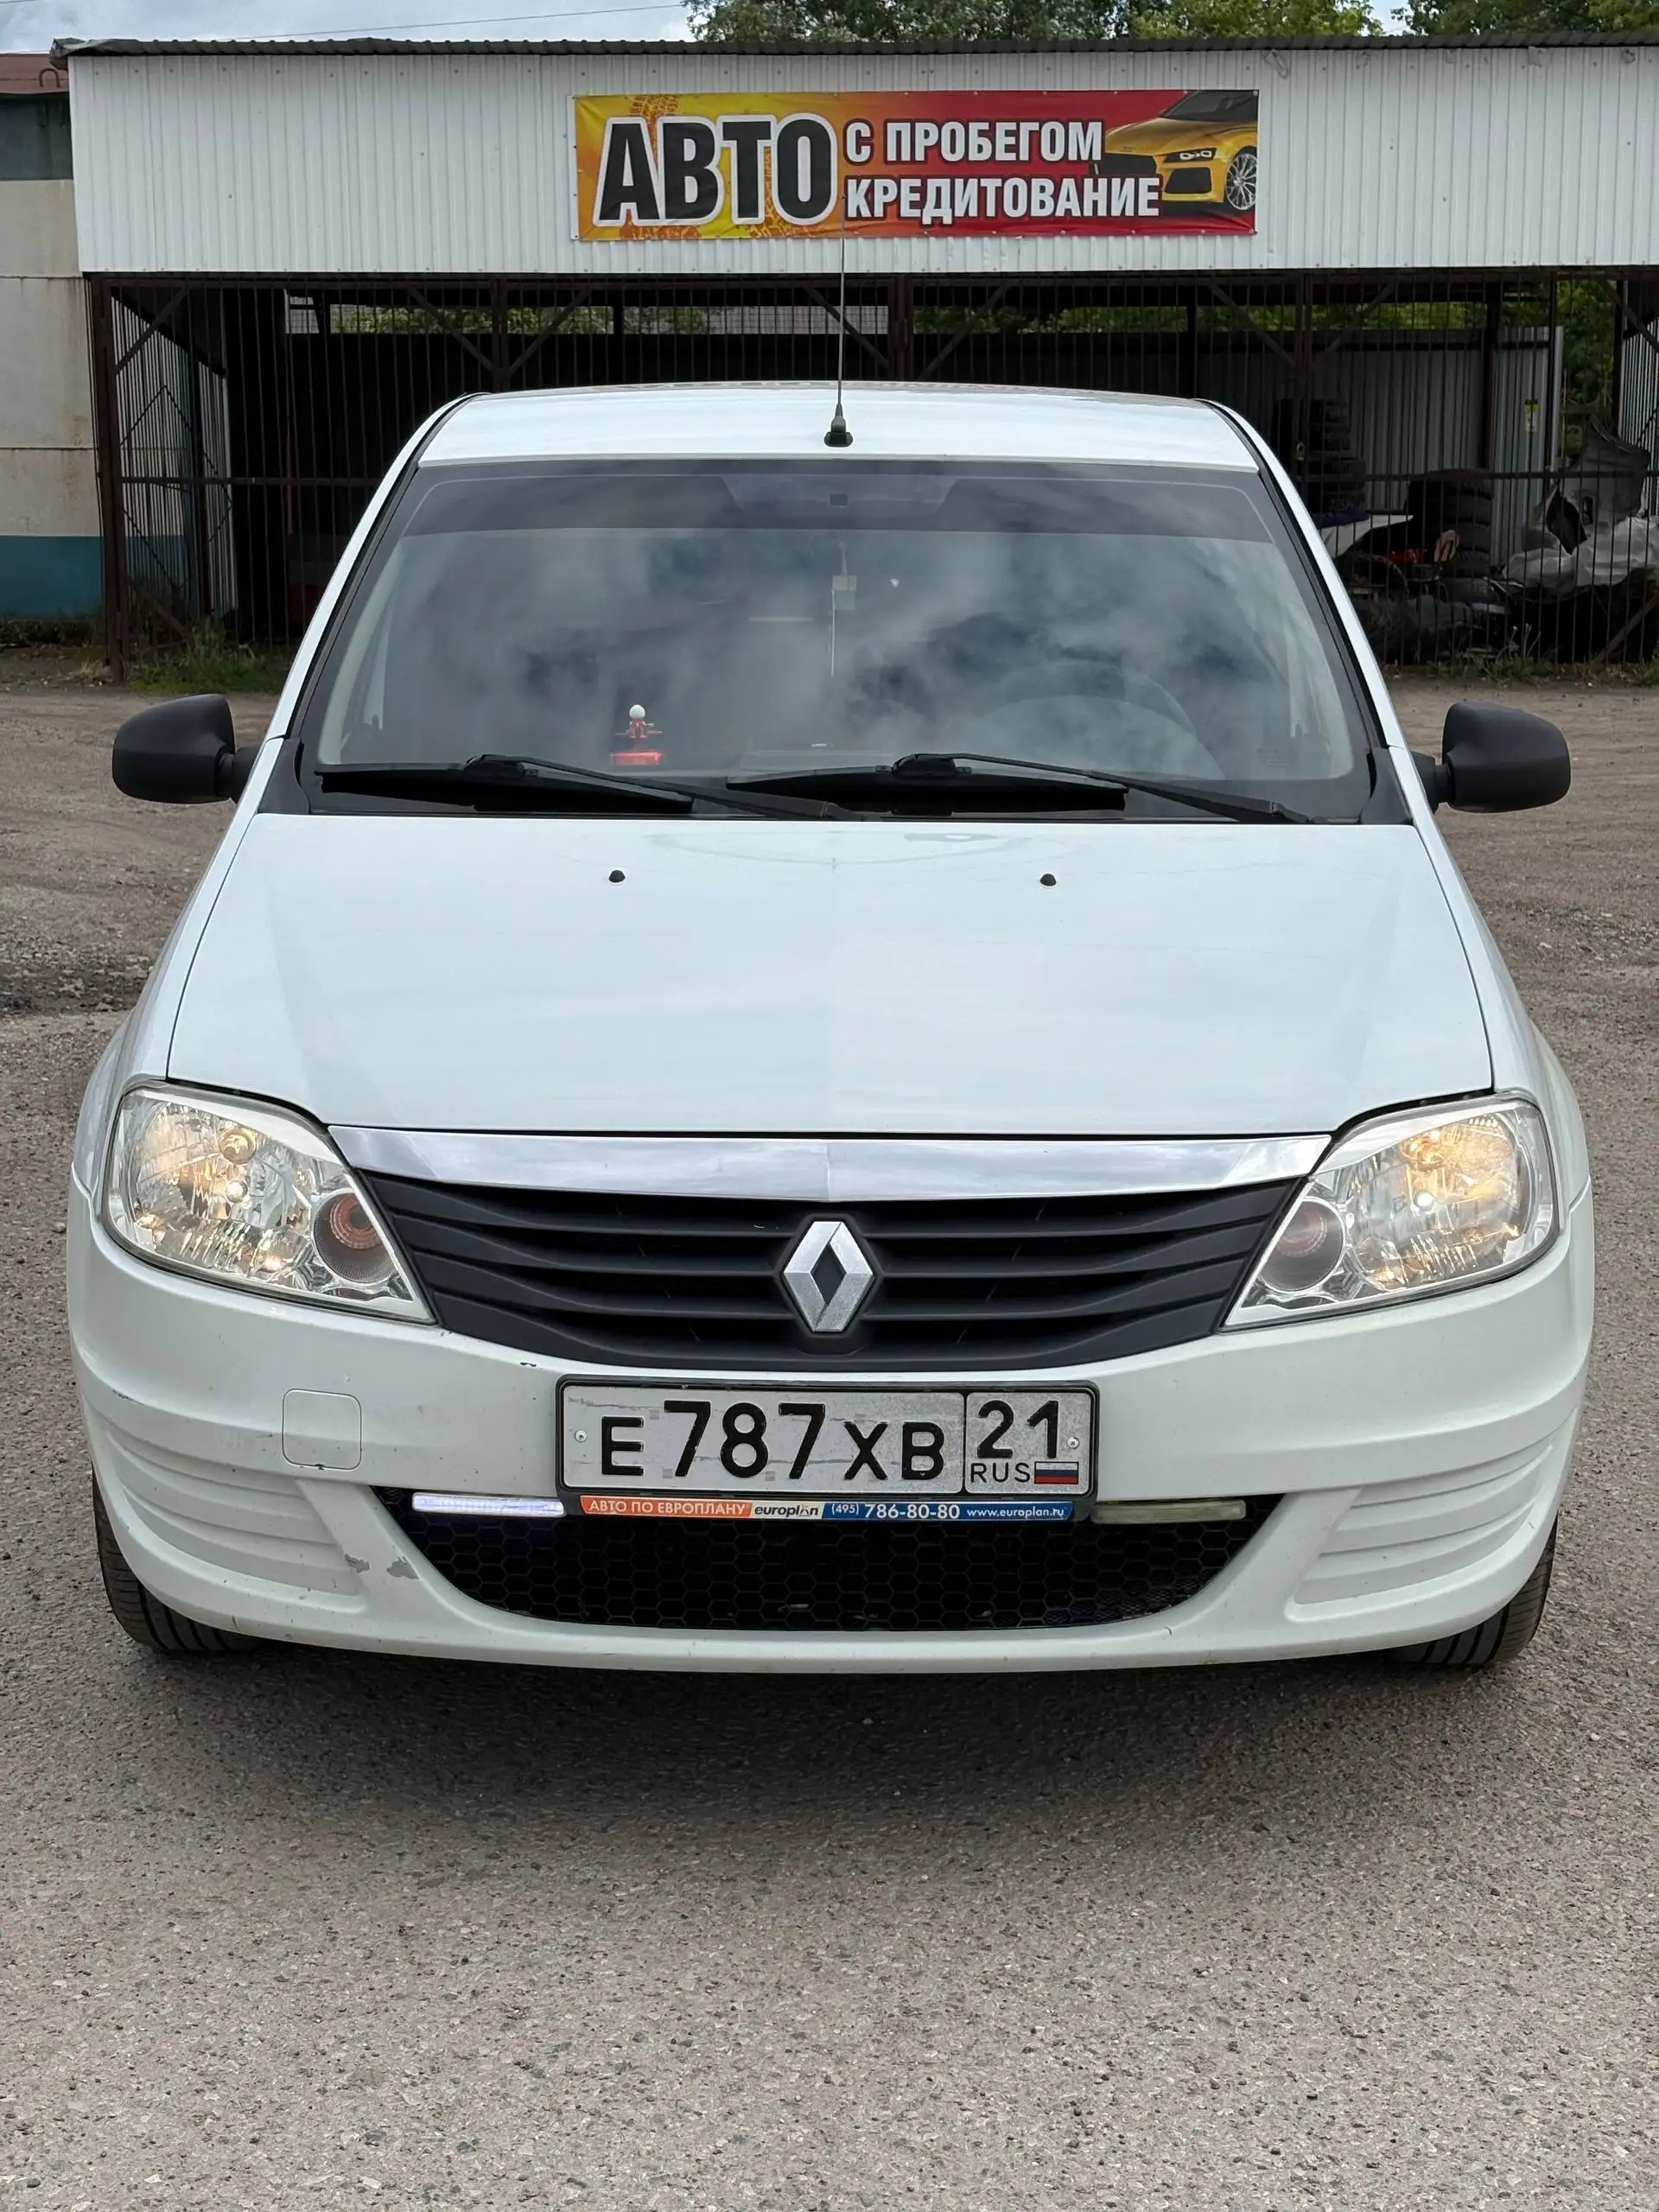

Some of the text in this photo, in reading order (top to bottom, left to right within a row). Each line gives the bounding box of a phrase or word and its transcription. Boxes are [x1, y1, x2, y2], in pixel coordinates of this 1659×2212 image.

[845, 121, 1103, 162] С ПРОБЕГОМ
[594, 113, 836, 225] АВТО
[847, 177, 1160, 225] КРЕДИТОВАНИЕ
[976, 1399, 1059, 1459] 21
[969, 1461, 1031, 1484] RUS
[588, 1500, 747, 1516] АВТО ПО ЕВРОПЛАНУ
[831, 1503, 1065, 1520] (495) 786-80-80 www.europlan.ru
